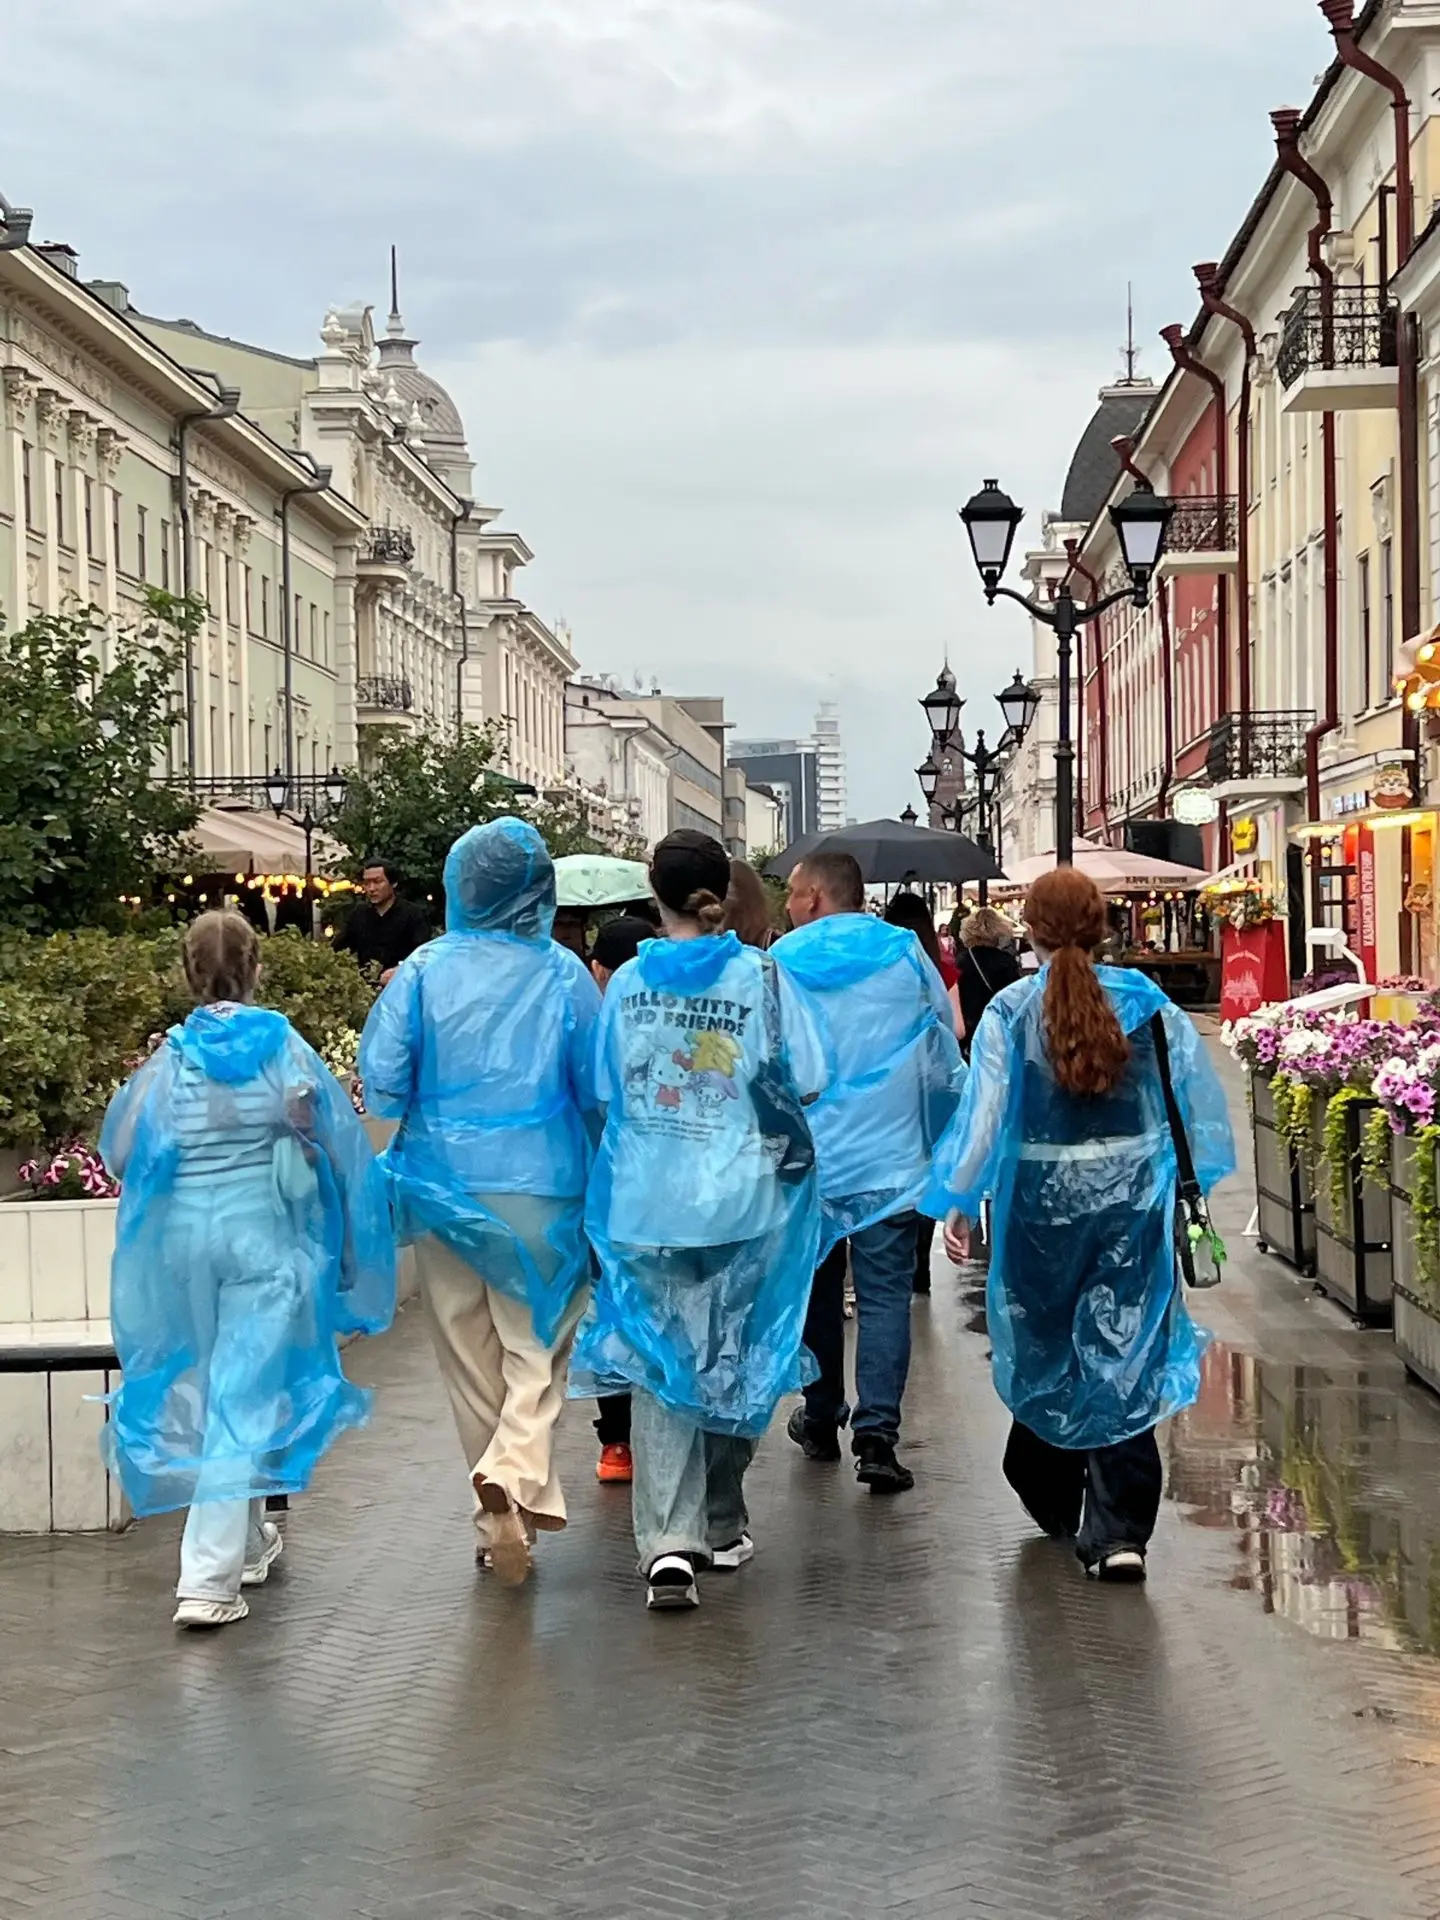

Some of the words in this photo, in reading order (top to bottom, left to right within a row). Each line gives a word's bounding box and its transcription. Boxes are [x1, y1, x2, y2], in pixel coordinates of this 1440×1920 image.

[1360, 893, 1374, 947] КАЗАНСКИЙ
[683, 997, 752, 1020] KITTY
[663, 1011, 746, 1036] FRIENDS
